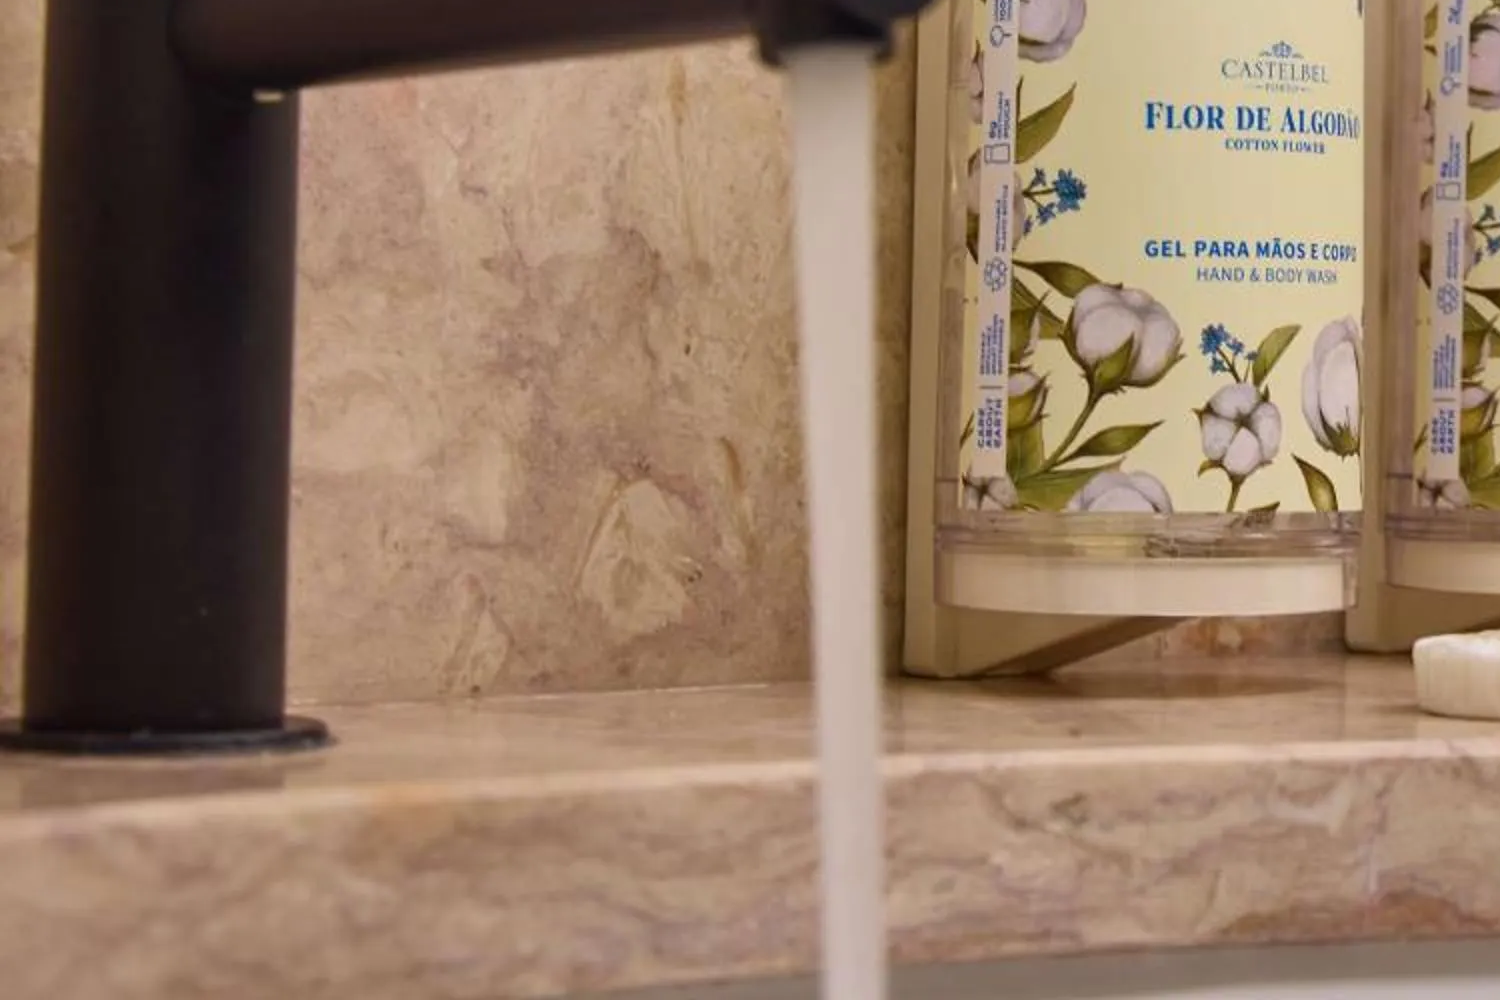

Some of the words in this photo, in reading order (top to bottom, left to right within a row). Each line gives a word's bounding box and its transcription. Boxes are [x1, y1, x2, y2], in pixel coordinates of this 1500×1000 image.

[1220, 58, 1330, 84] CASTELBEL
[1145, 101, 1225, 130] FLOR
[1235, 105, 1271, 132] DE
[1224, 138, 1279, 152] COTTON
[1283, 139, 1326, 154] FLOWER
[1144, 240, 1186, 258] GEL
[1194, 240, 1250, 259] PARA
[1255, 237, 1306, 260] MÃOS
[1311, 243, 1319, 260] E
[1196, 267, 1245, 282] HAND
[1249, 267, 1260, 282] &
[1265, 267, 1303, 284] BODY
